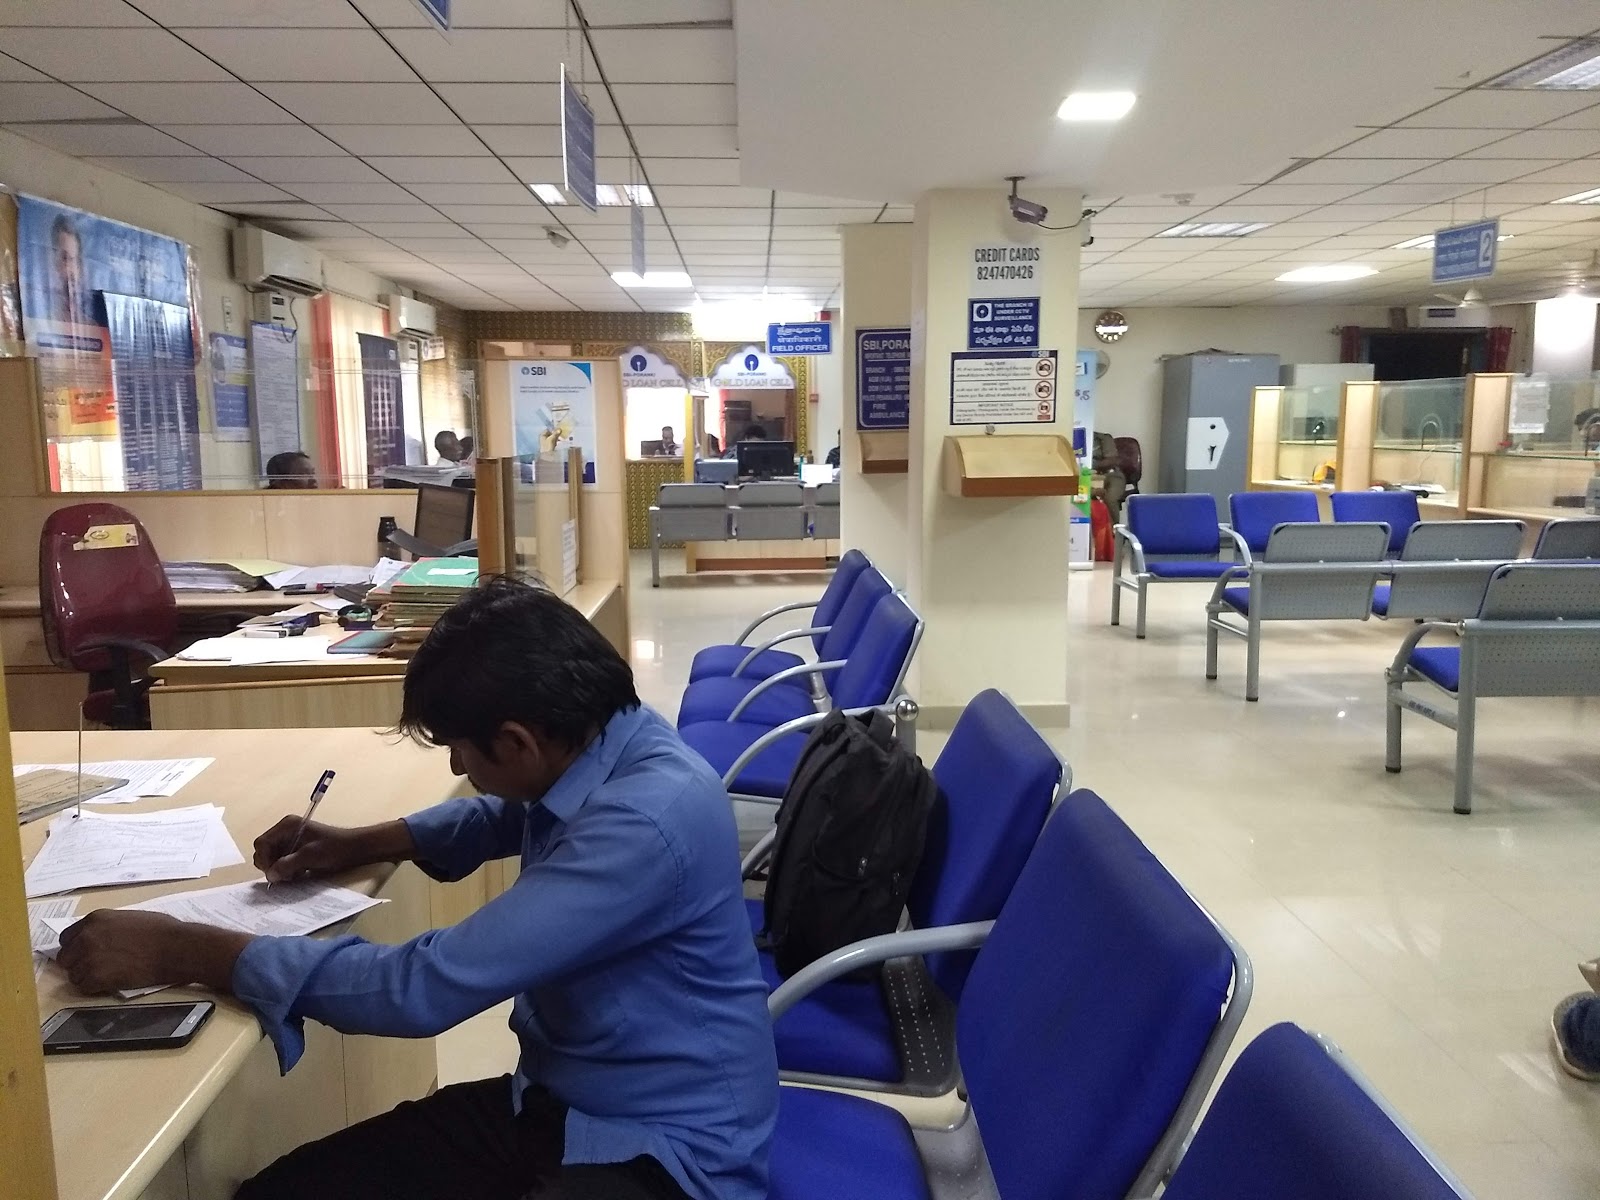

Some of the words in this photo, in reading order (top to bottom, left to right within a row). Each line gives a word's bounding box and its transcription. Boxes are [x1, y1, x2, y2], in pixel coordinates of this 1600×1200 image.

[1482, 232, 1492, 262] 2
[974, 248, 1007, 262] CREDIT
[1009, 247, 1040, 261] CARDS
[977, 265, 1034, 280] 8247470426
[531, 366, 547, 375] SBI
[630, 379, 657, 387] LOAN
[659, 379, 683, 387] CELL
[714, 379, 743, 387] GOLD
[744, 379, 768, 387] LOAN
[770, 379, 791, 387] CELL
